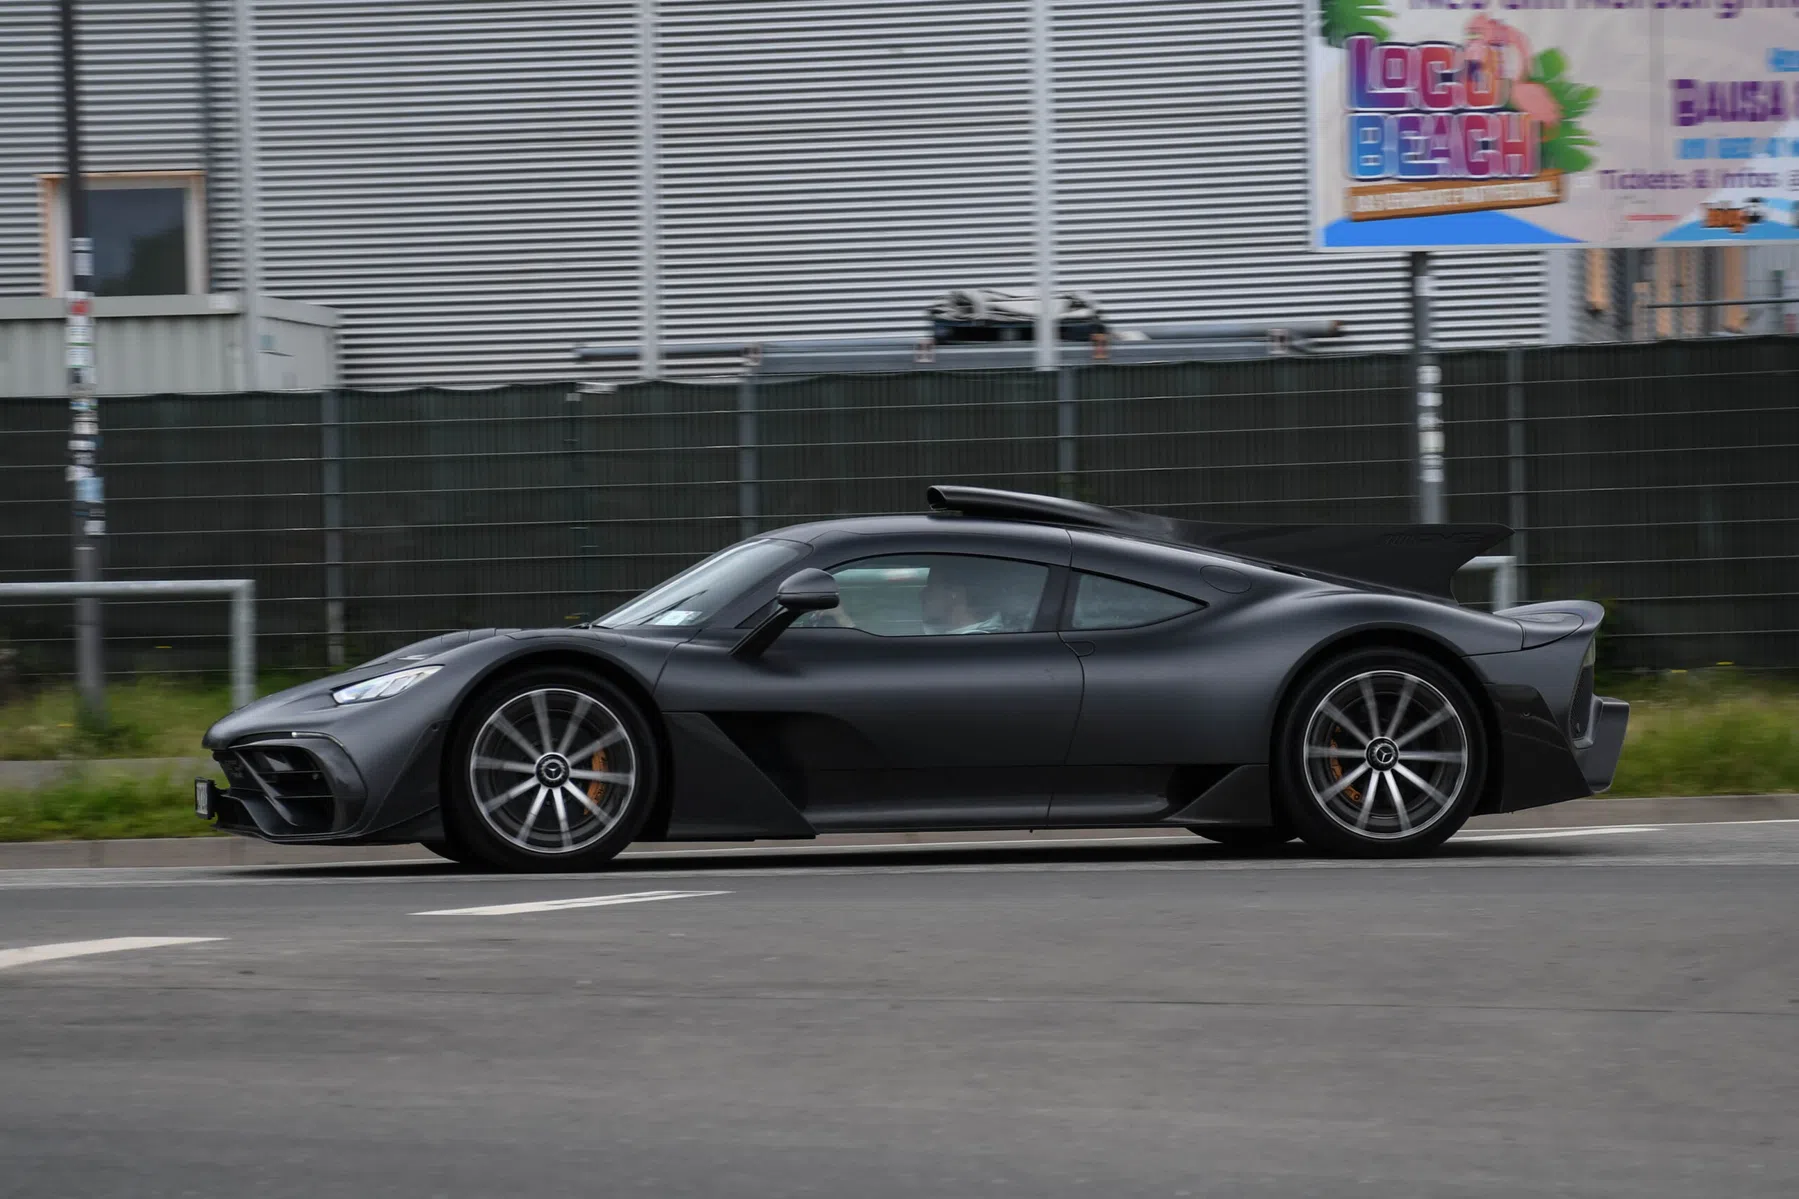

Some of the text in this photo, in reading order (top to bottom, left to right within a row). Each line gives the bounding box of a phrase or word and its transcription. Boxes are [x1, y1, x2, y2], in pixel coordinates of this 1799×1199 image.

[1344, 32, 1504, 111] LOCO
[1345, 110, 1538, 181] BEACH
[1598, 168, 1685, 189] Tickets
